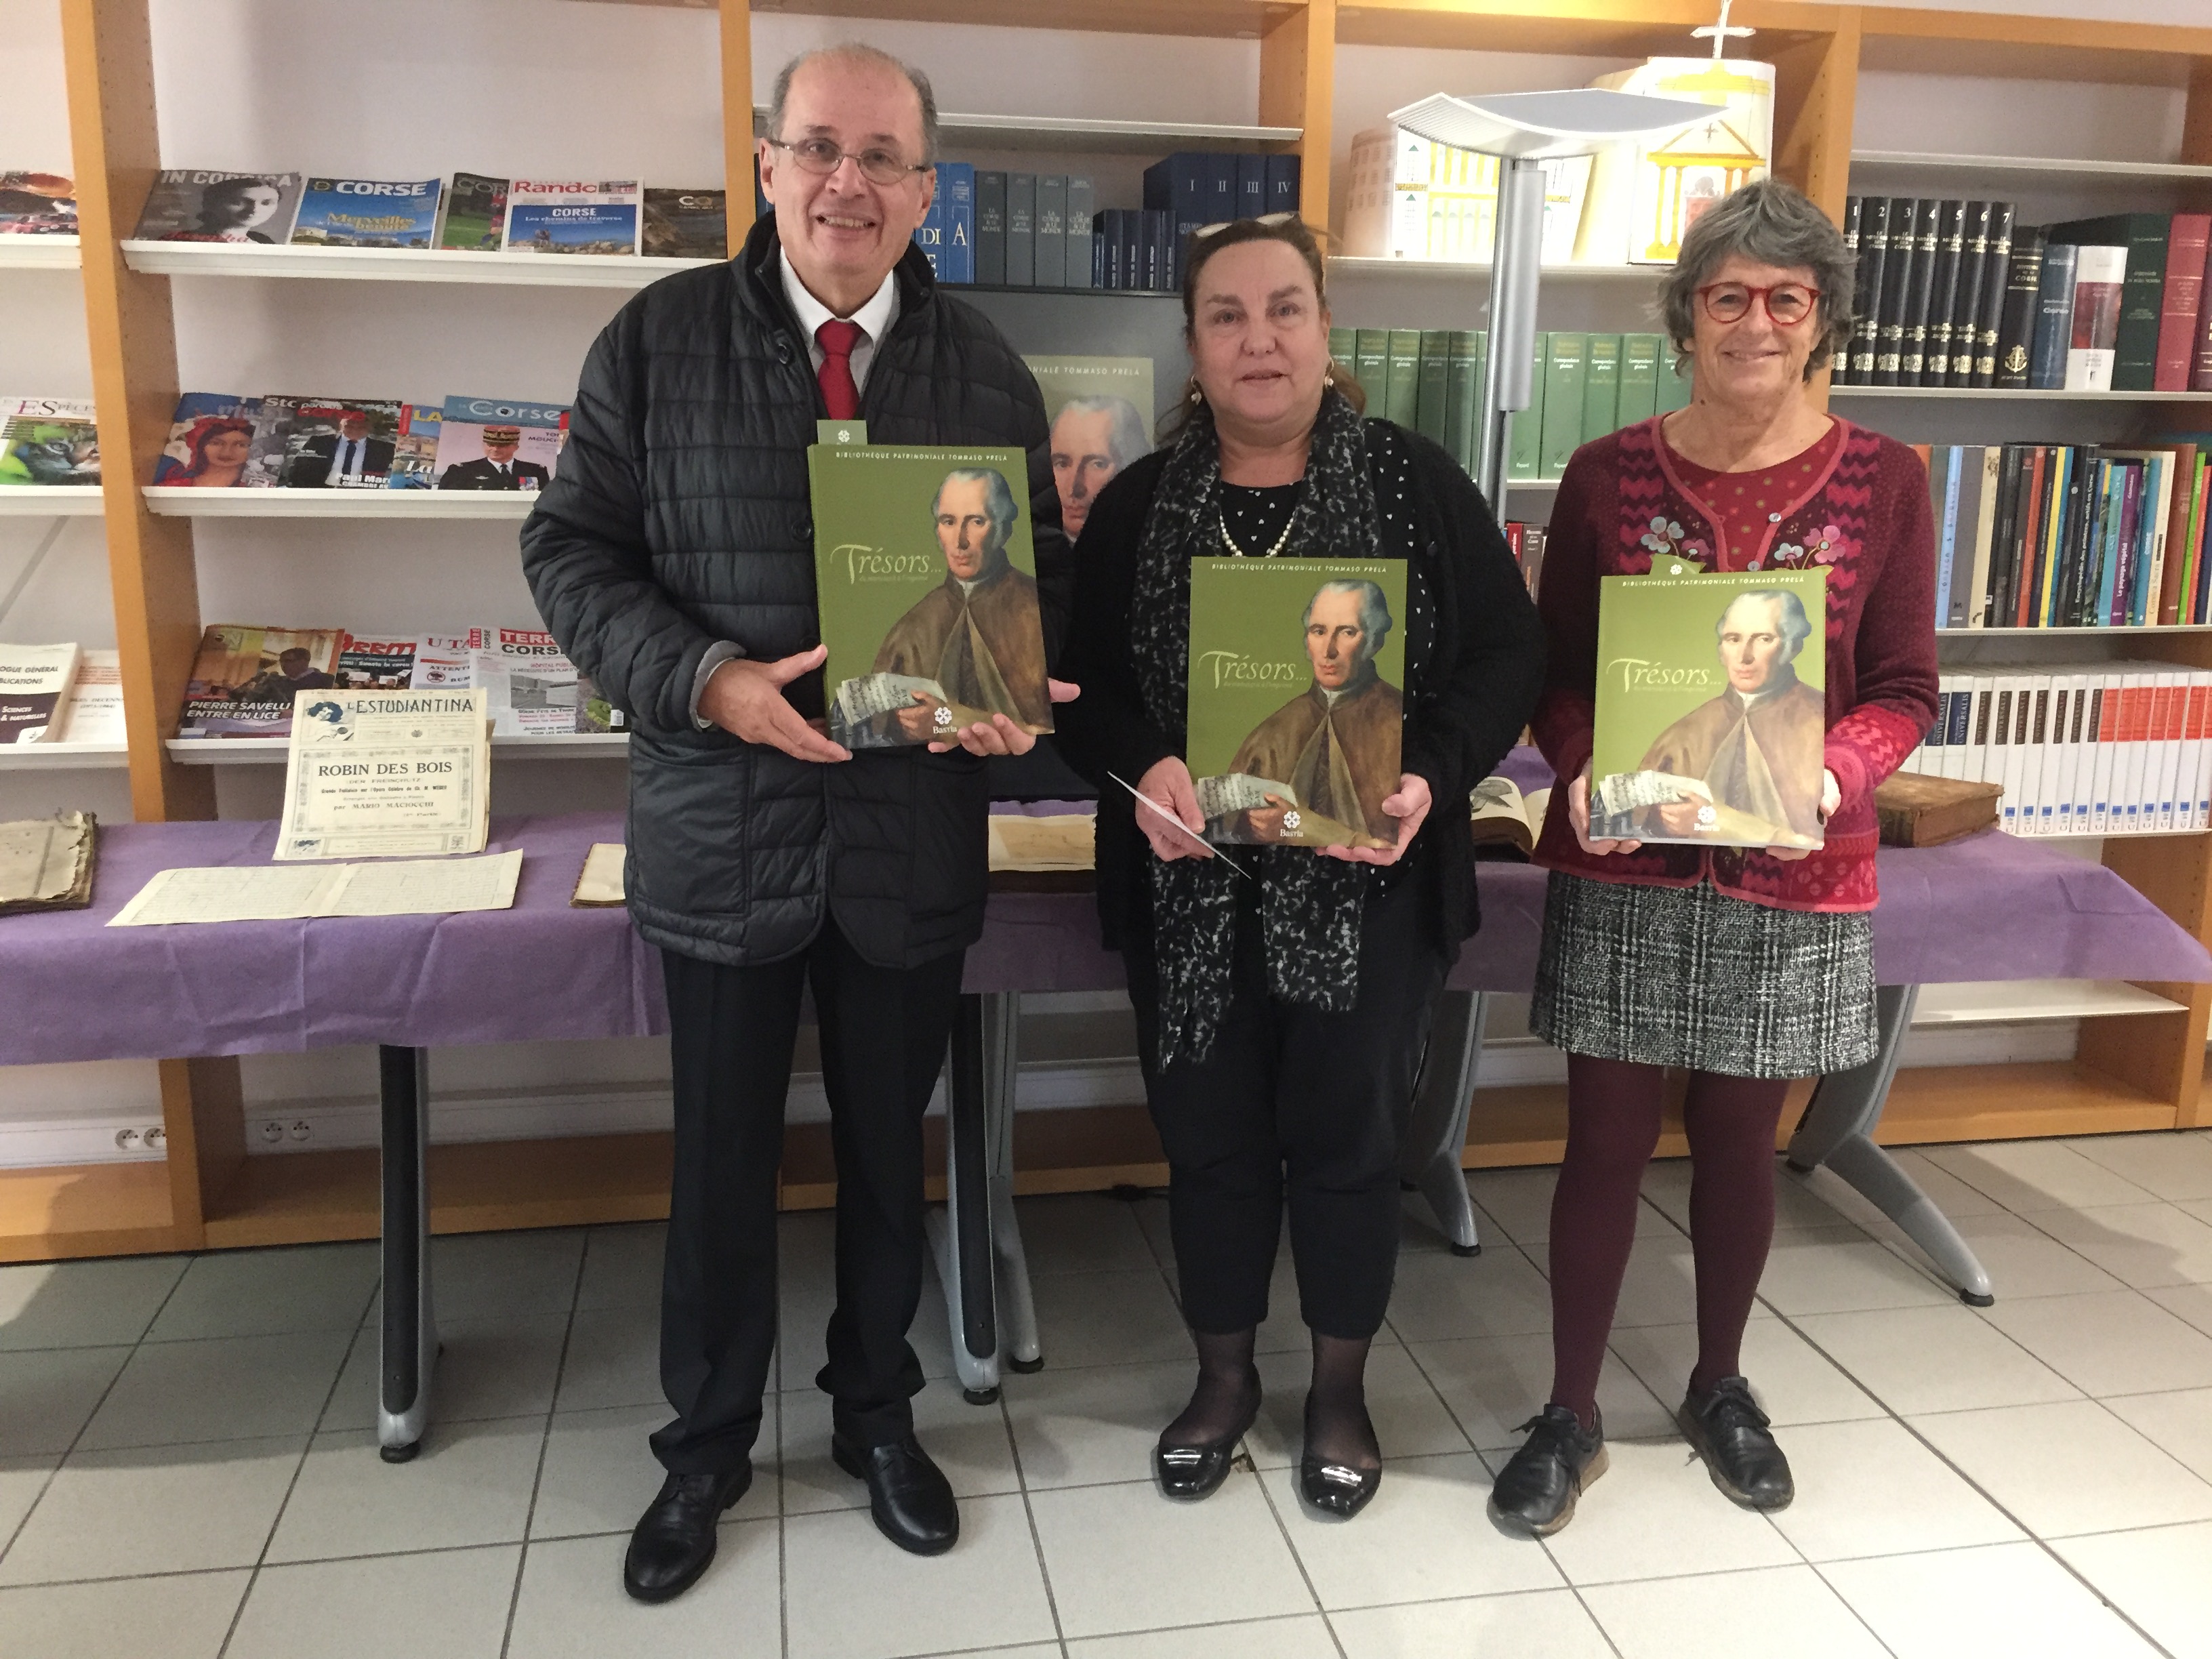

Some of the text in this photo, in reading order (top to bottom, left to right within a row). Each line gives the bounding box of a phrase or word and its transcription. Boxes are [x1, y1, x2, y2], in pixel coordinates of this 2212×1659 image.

[336, 181, 427, 196] CORSE
[514, 181, 596, 194] Rando
[1218, 180, 1227, 192] II
[1247, 182, 1258, 193] III
[1277, 182, 1291, 194] IV
[552, 208, 596, 217] CORSE
[1853, 205, 1858, 216] 1
[1878, 206, 1885, 217] 2
[1904, 207, 1911, 218] 3
[1929, 209, 1936, 220] 4
[1955, 209, 1963, 220] 5
[1980, 211, 1988, 222] 6
[2003, 212, 2010, 224] 7
[951, 222, 967, 245] A
[1065, 367, 1107, 375] TOMMASO
[414, 410, 443, 422] LA
[469, 400, 560, 421] Corse
[407, 460, 434, 474] La
[428, 638, 443, 648] U
[472, 628, 481, 649] TERRE
[189, 701, 291, 710] PIERRE SAVELLI
[186, 710, 281, 720] ENTRE EN LICE
[1936, 695, 1948, 745] UNIVERSALIS
[1957, 693, 1969, 744] UNIVERSALIS
[933, 725, 958, 734] Bastia
[319, 762, 453, 777] ROBIN DES BOIS
[1279, 829, 1304, 838] Bastia
